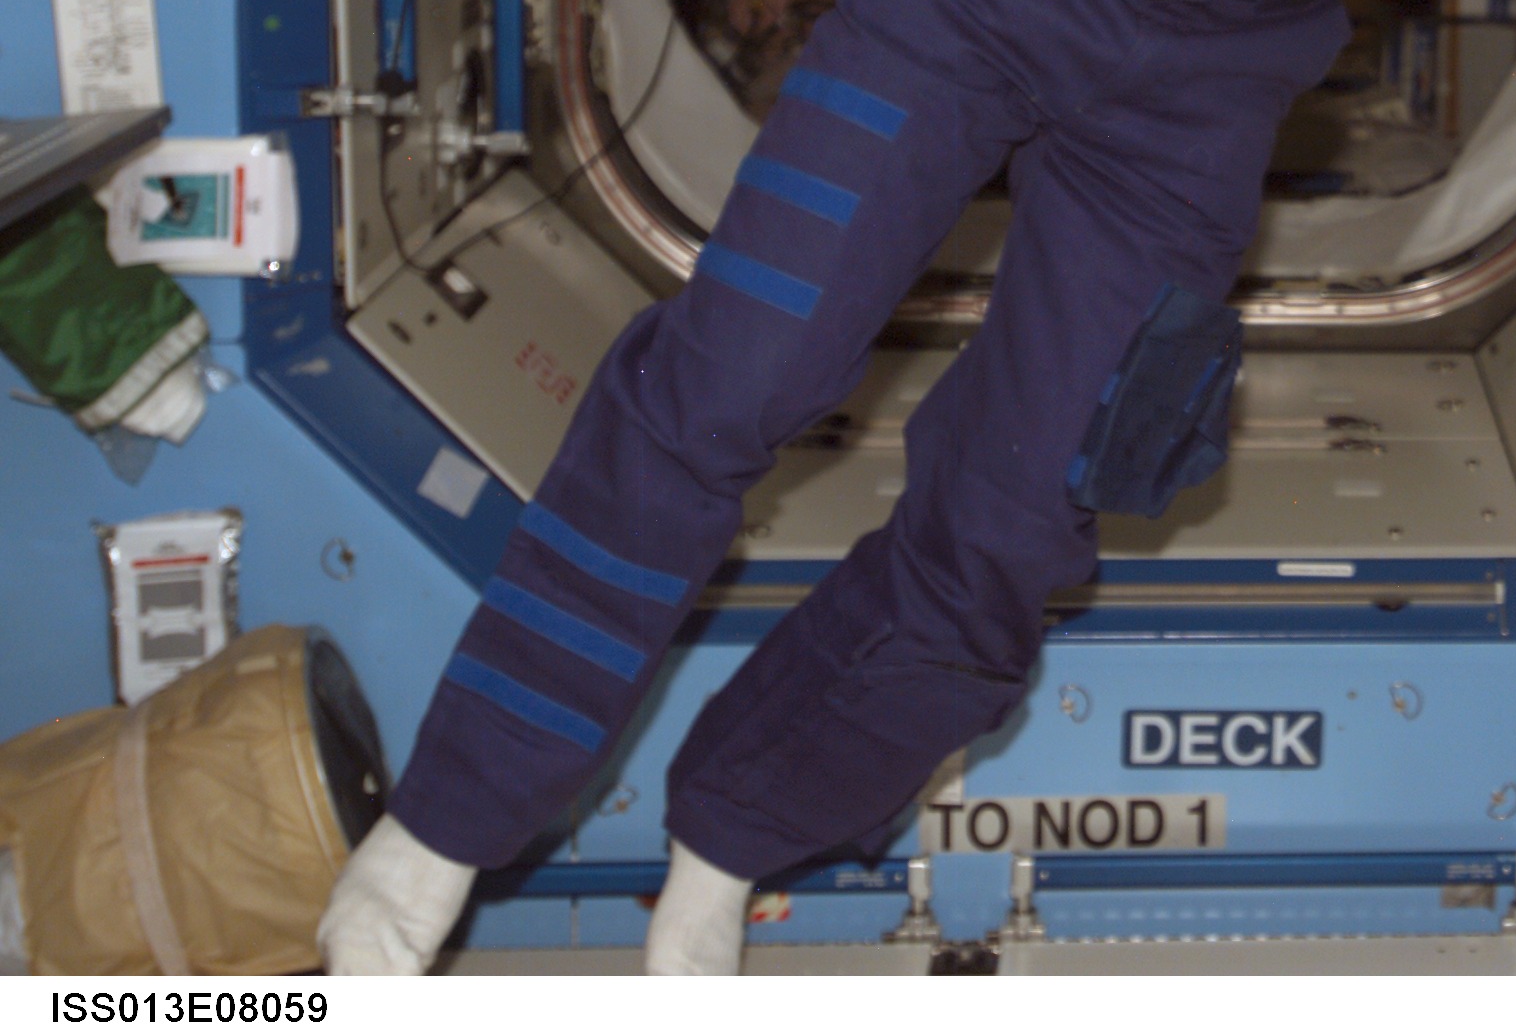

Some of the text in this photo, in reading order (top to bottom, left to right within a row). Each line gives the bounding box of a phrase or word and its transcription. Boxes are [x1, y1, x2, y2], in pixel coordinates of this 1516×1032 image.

[1130, 715, 1317, 765] DECK
[927, 800, 1209, 851] TO NOD 1
